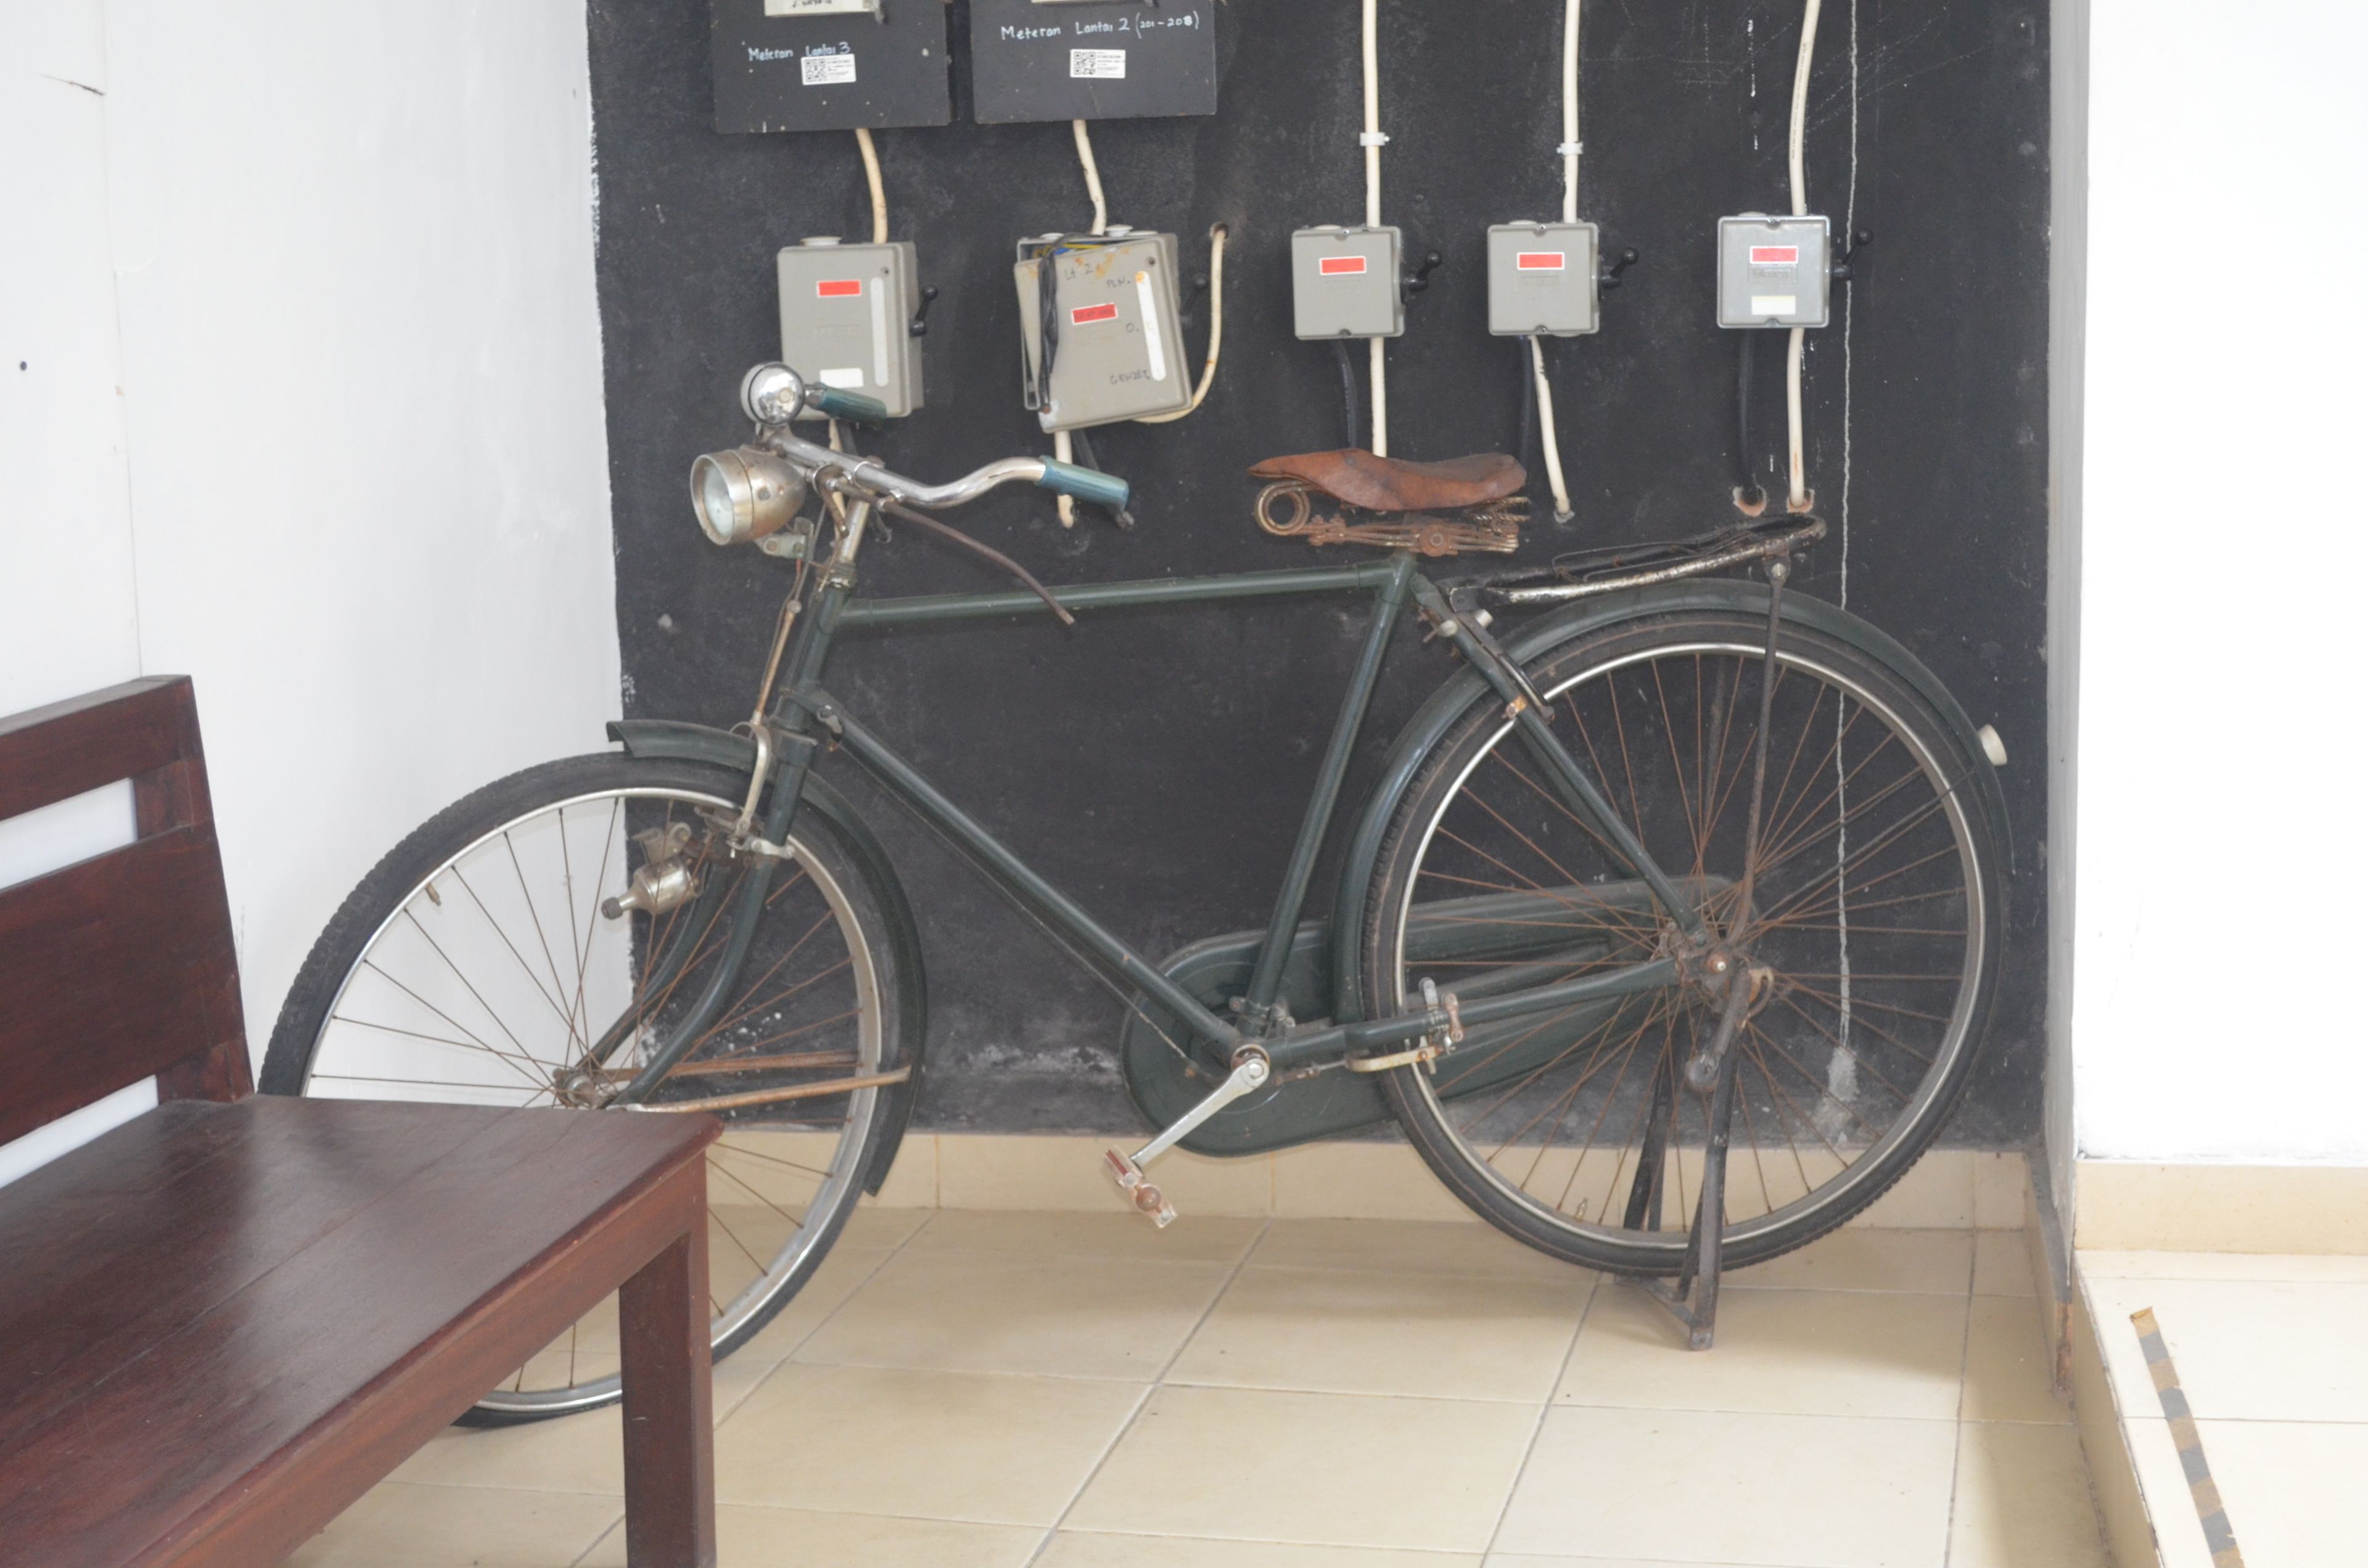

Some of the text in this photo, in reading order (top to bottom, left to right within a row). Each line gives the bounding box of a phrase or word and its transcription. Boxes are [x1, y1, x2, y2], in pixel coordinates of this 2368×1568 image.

[1001, 25, 1061, 40] Meteran
[1075, 22, 1113, 35] Lantai
[1118, 17, 1130, 30] 2
[747, 41, 851, 61] Meteran Lantai 3
